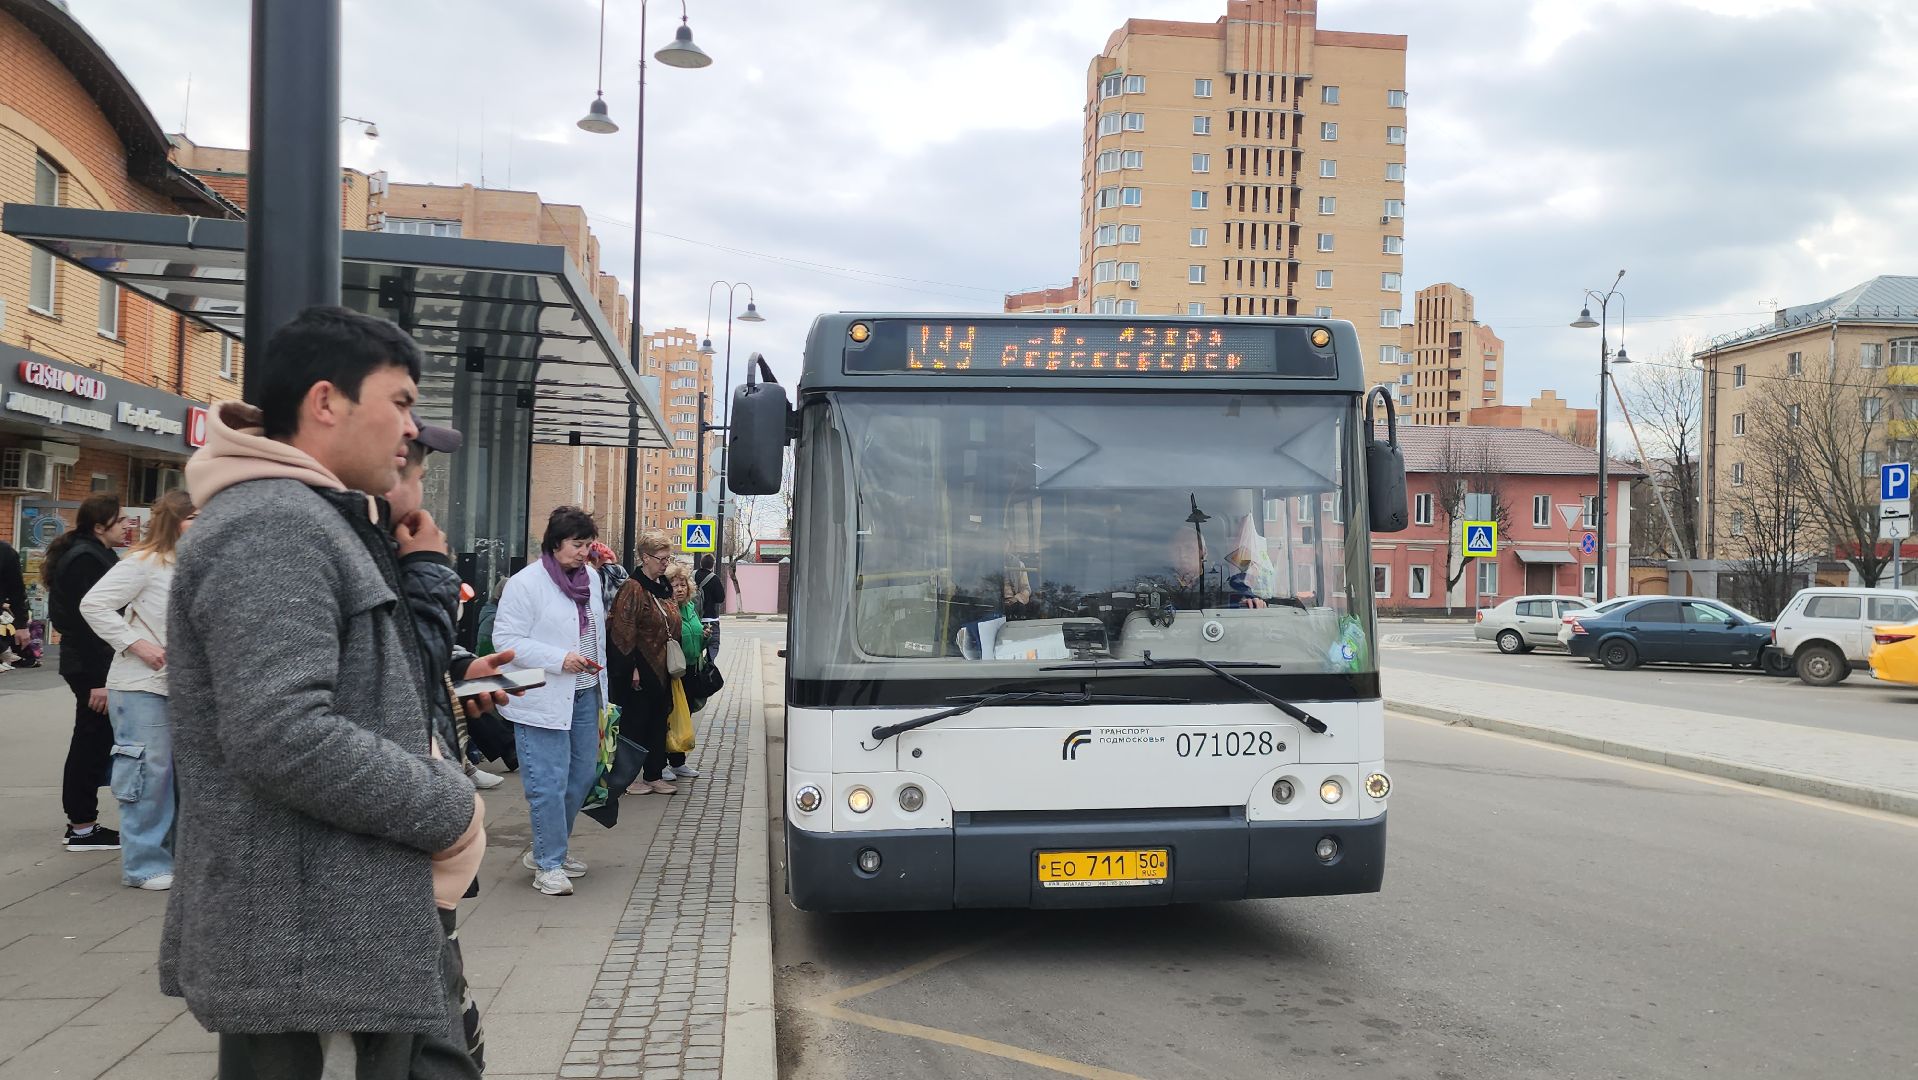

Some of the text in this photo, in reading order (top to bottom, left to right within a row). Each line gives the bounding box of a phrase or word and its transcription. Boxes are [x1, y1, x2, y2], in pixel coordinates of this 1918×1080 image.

[1888, 467, 1905, 497] P
[1099, 736, 1166, 744] ПОДМОСКОВЬЯ
[1176, 731, 1273, 758] 071028
[1086, 855, 1125, 876] 711
[1139, 853, 1159, 869] 50
[1141, 869, 1157, 877] RUS
